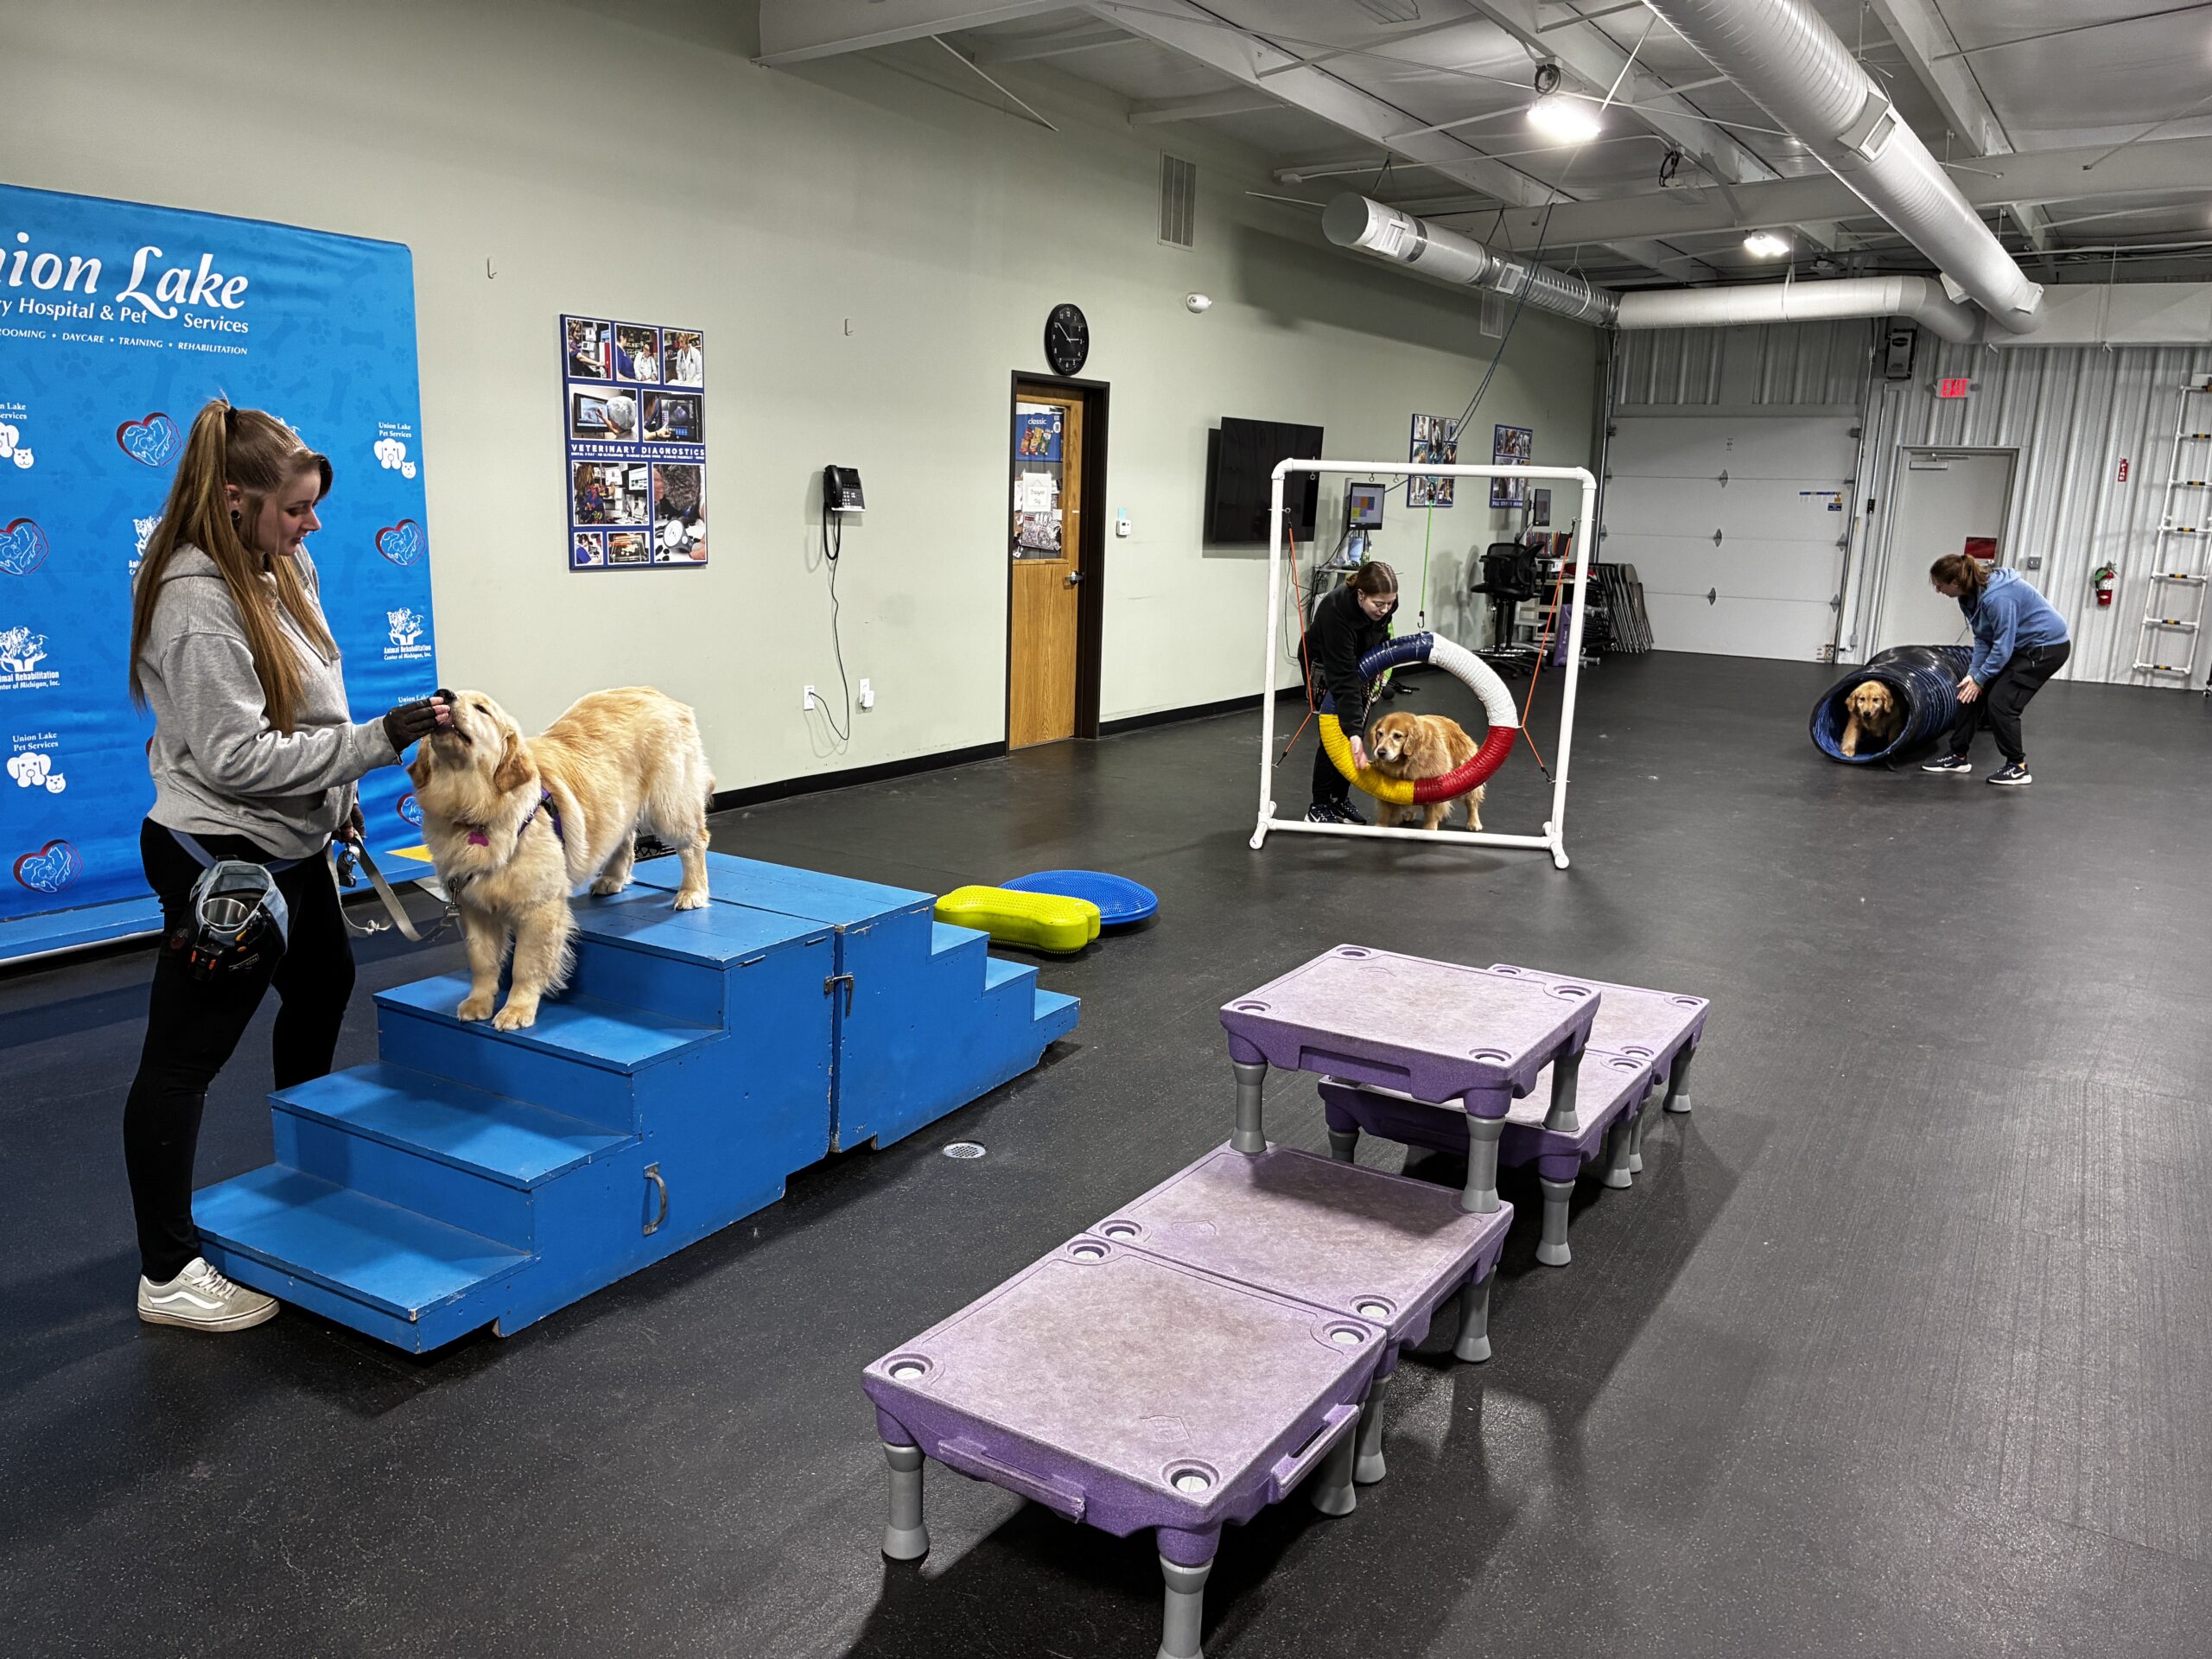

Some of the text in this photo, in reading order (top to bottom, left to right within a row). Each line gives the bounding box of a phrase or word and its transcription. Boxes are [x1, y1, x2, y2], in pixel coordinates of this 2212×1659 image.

[0, 232, 249, 320] ion Lake
[19, 297, 95, 321] Hospital
[99, 305, 114, 321] &
[120, 307, 148, 324] Pet
[183, 313, 249, 334] Services
[0, 328, 248, 355] OOMING DAYCARE TRAINING REHABILITATION
[1942, 378, 1968, 397] EXIT
[7, 402, 26, 410] Lake
[571, 443, 636, 454] VETERINARY
[641, 446, 705, 456] DIAGNOSTICS
[16, 671, 60, 681] Rehabilitation
[20, 680, 48, 689] Michigan,
[12, 734, 36, 743] Union
[28, 741, 59, 750] Services
